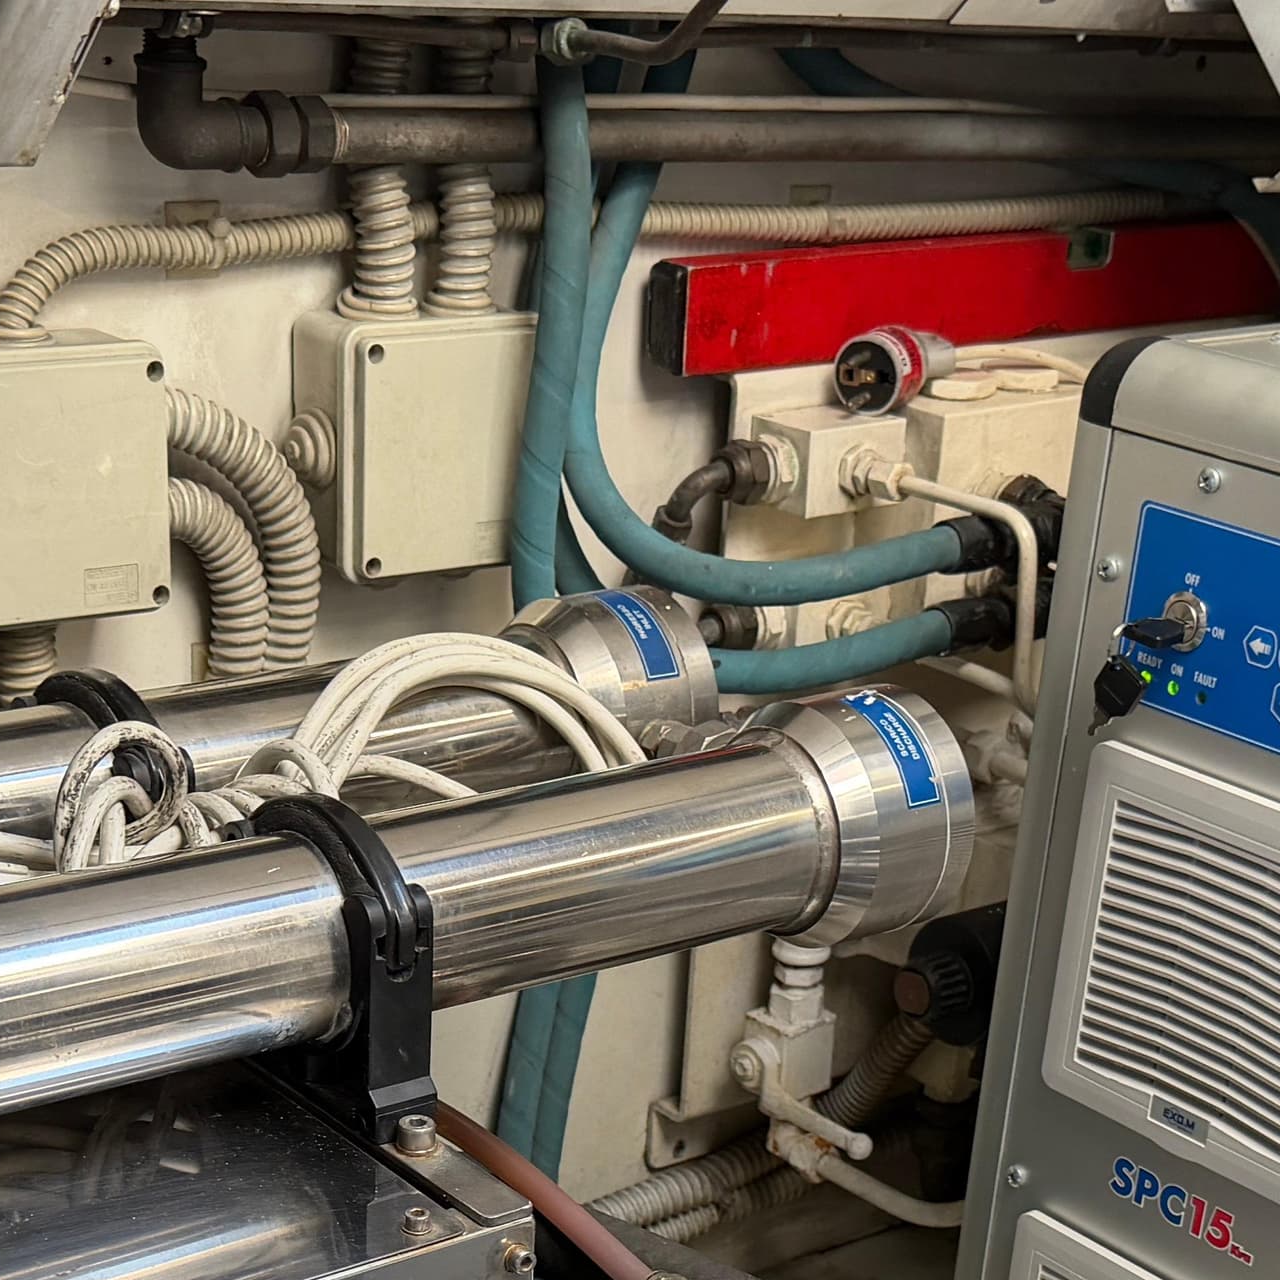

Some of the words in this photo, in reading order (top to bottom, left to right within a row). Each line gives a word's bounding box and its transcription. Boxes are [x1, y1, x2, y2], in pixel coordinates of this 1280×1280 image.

[1185, 573, 1200, 588] OFF
[1211, 626, 1225, 641] ON
[1137, 651, 1163, 670] READY
[1170, 663, 1184, 678] ON
[1193, 671, 1218, 688] FAULT
